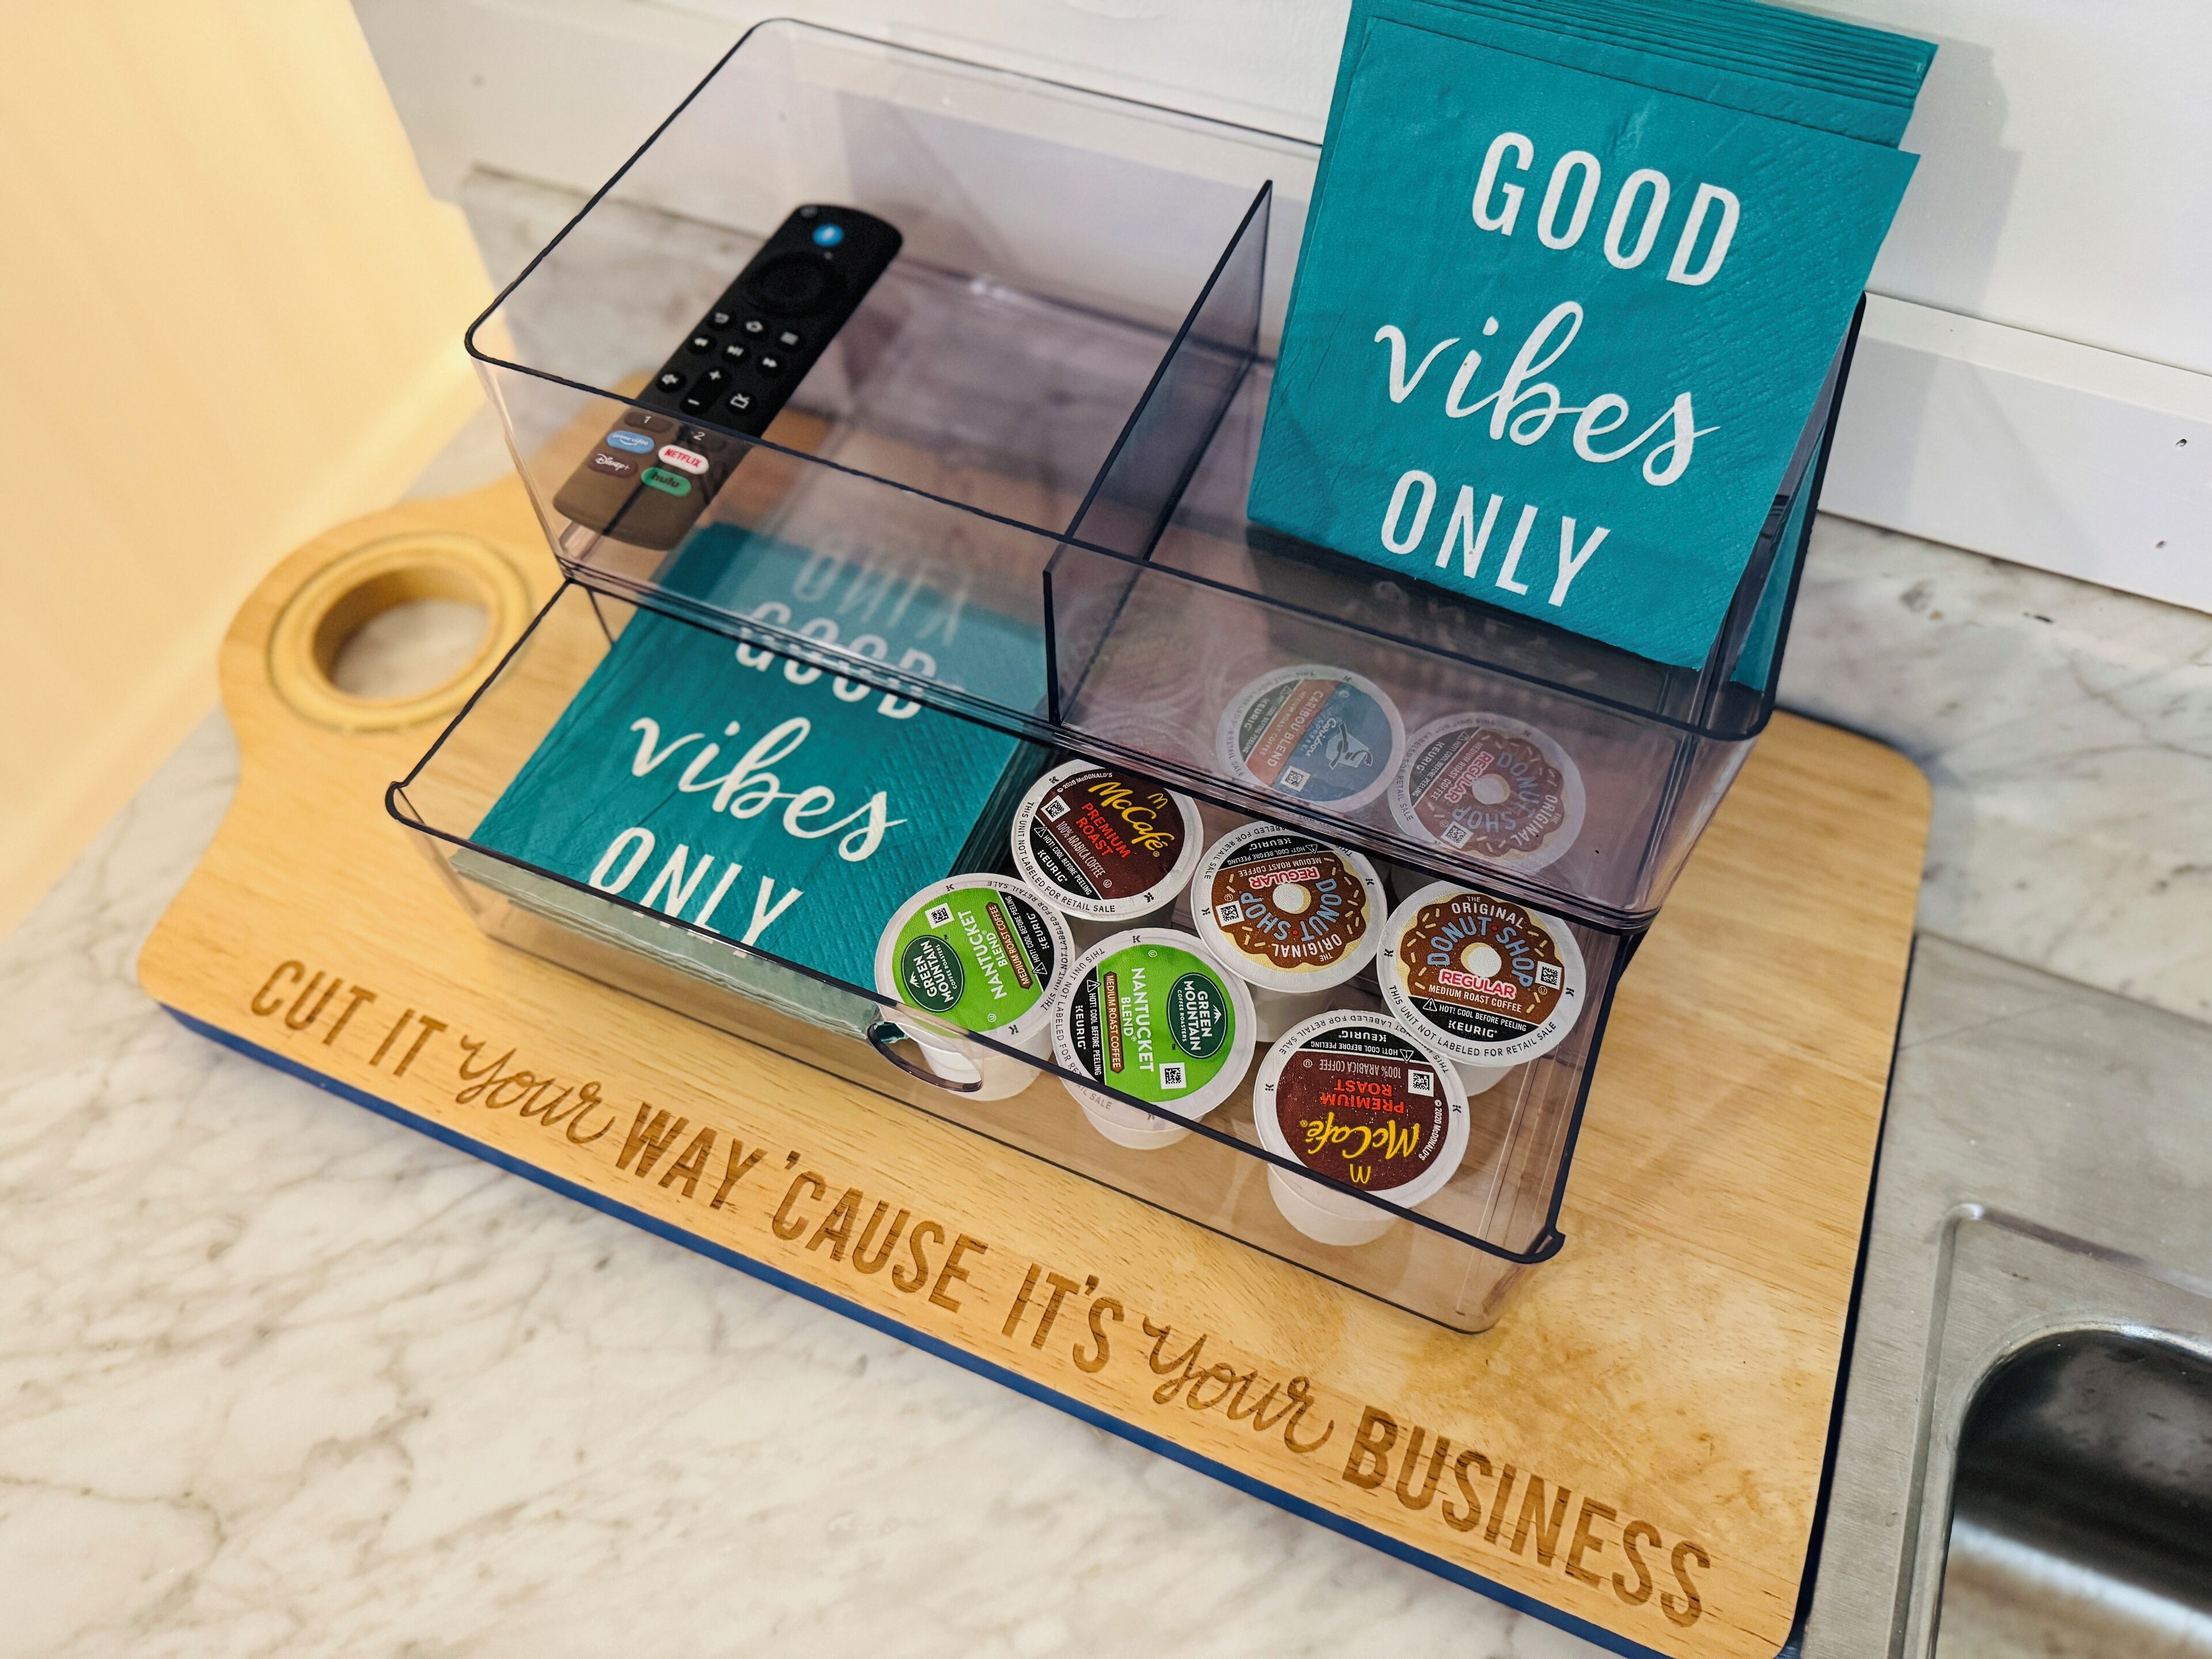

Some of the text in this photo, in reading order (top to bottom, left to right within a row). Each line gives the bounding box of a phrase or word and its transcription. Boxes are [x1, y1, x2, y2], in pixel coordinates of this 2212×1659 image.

[1472, 132, 1741, 286] GOOD
[1373, 300, 1721, 486] vibes
[693, 432, 705, 440] 2
[665, 449, 702, 468] NETFLIX
[652, 472, 680, 488] hulu
[1381, 469, 1610, 608] ONLY
[735, 601, 937, 720] GOOD
[1290, 691, 1323, 732] CARIBOU
[1267, 732, 1294, 767] BLEND
[630, 717, 907, 862] vibes
[1445, 751, 1495, 802] REGULAR
[1452, 751, 1539, 832] DONUT SHOP
[1022, 802, 1034, 818] THIS
[1510, 794, 1558, 845] ORIGINAL
[1017, 820, 1027, 837] UNIT
[1076, 817, 1114, 856] ROAST
[1081, 802, 1131, 858] PREMIUM
[1018, 840, 1027, 855] NOT
[1056, 821, 1105, 878] 100% ARABICA COFFEE
[1204, 831, 1252, 879] FOR RETAIL SALE
[1228, 855, 1249, 865] PEELING
[1251, 851, 1271, 860] BEFORE
[1021, 858, 1045, 887] LABELED
[1043, 835, 1092, 895] HOT! COOL BEFORE PEELING
[1238, 857, 1322, 877] MEDIUM ROAST COFFEE
[1250, 866, 1320, 889] REGULAR
[589, 827, 804, 959] ONLY
[1012, 886, 1037, 903] RETAIL
[1038, 901, 1053, 917] FOR
[1044, 886, 1060, 900] FOR
[1060, 896, 1090, 911] RETAIL
[1240, 878, 1342, 942] DONUT SHOP
[1005, 896, 1041, 963] HOT! COOL BEFORE PEELING
[1050, 916, 1068, 950] LABELED
[1451, 903, 1524, 929] ORIGINAL
[958, 910, 1007, 999] NANTUCKET
[989, 905, 1030, 985] MEDIUM ROAST COFFEE
[1060, 952, 1069, 969] NOT
[1085, 948, 1105, 963] THIS
[1272, 935, 1342, 958] ORIGINAL
[1319, 954, 1333, 962] THE
[1427, 916, 1535, 988] DONUT SHOP
[914, 957, 938, 998] GREEN
[921, 940, 954, 1003] MOUNTAIN
[935, 945, 957, 989] COFFEE ROASTERS
[1071, 963, 1086, 980] UNIT
[1439, 970, 1516, 998] REGULAR
[1060, 981, 1073, 999] NOT
[1177, 990, 1185, 1012] COFFEE
[1429, 984, 1522, 1013] MEDIUM ROAST COFFEE
[1055, 1001, 1066, 1040] LABELED
[1105, 975, 1121, 1068] MEDIUM ROAST COFFEE
[1131, 967, 1153, 1072] NANTUCKET
[1184, 980, 1201, 1051] MOUNTAIN
[1197, 991, 1213, 1036] GREEN
[1389, 986, 1403, 1005] THIS
[1401, 1007, 1418, 1026] UNIT
[1418, 1024, 1436, 1040] NOT
[1438, 1037, 1480, 1056] LABELED
[1484, 1048, 1503, 1056] FOR
[1506, 1038, 1536, 1054] RETAIL
[1537, 1021, 1556, 1040] SALE
[1439, 1005, 1526, 1032] HOT! COOL BEFORE PEELING
[1088, 993, 1102, 1075] HOT! COOL BEFORE PEELING
[1279, 1015, 1392, 1055] LABELED FOR RETAIL SALE
[1339, 1043, 1362, 1051] BEFORE
[1059, 1043, 1071, 1061] FOR
[1319, 1059, 1401, 1078] 100% ARABICA COFFEE
[1433, 1054, 1449, 1074] THIS
[1090, 1096, 1112, 1110] SALE
[1322, 1092, 1404, 1113] PREMIUM
[1334, 1079, 1393, 1096] ROAST
[1418, 1123, 1442, 1161] McDONALD'S
[251, 960, 1711, 1629] CUT IT your WAY 'CAUSE IT'S your BUSINESS
